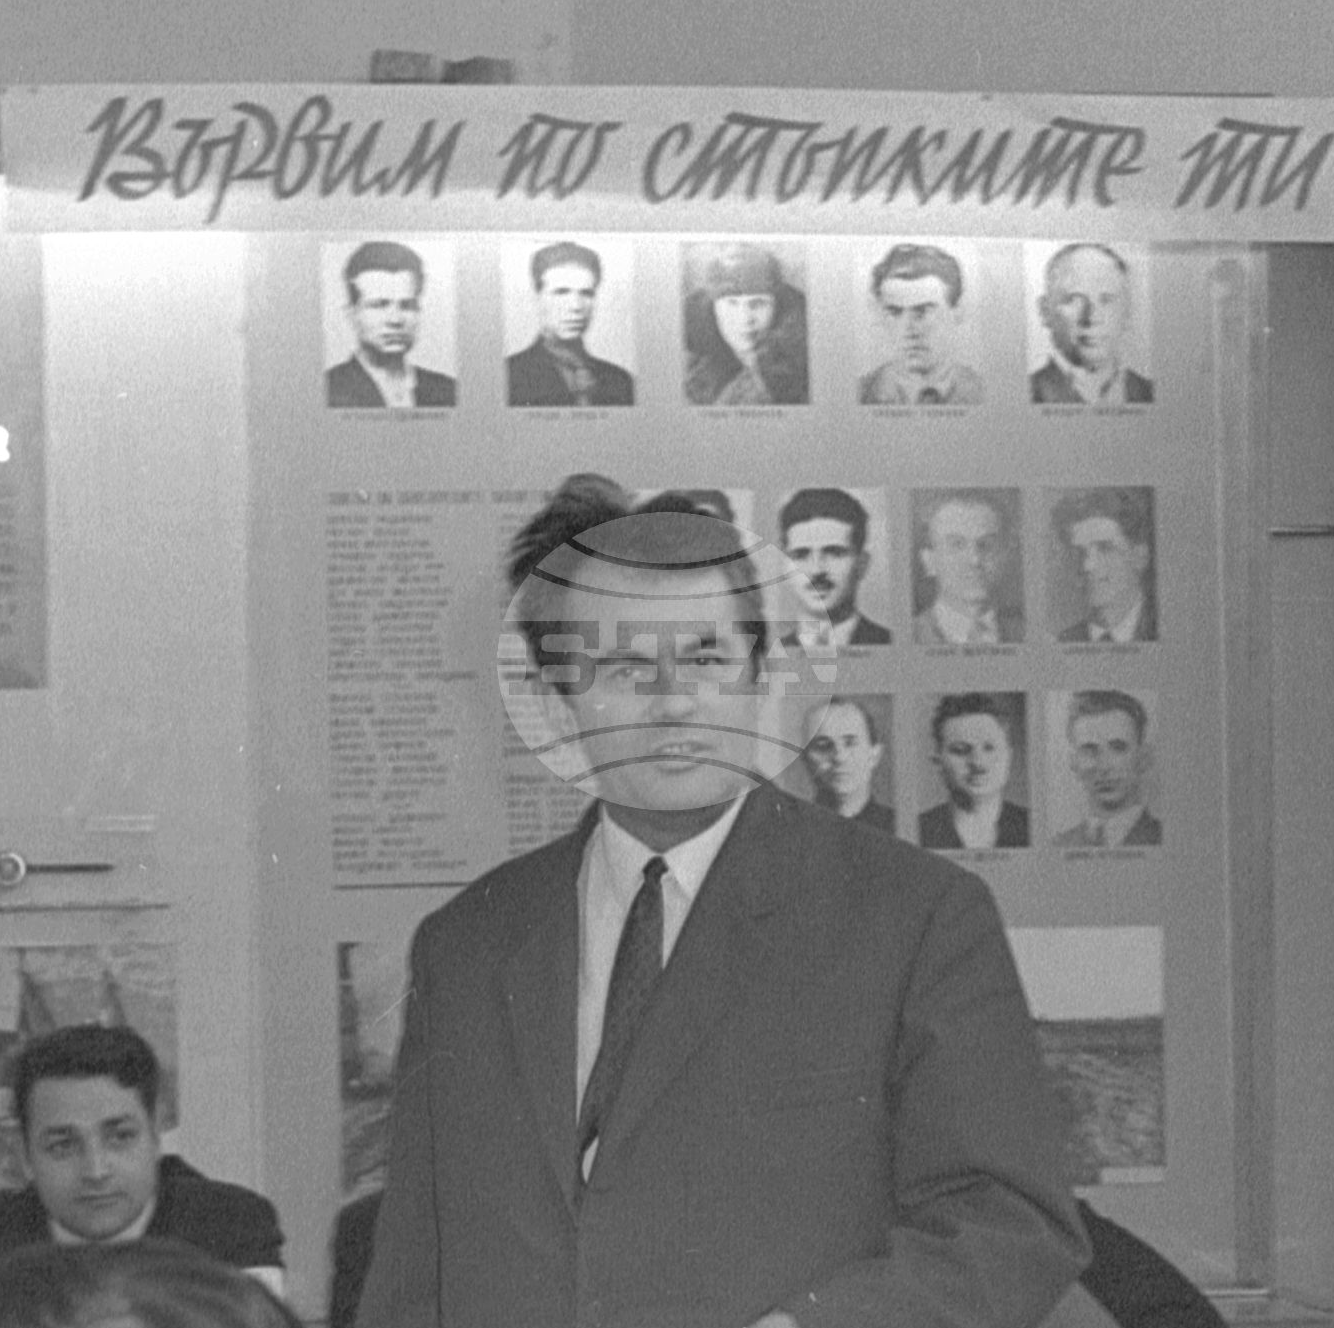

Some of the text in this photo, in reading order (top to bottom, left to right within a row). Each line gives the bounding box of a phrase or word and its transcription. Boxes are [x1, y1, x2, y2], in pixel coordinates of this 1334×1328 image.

[76, 94, 464, 224] Вървим
[497, 112, 623, 201] по
[640, 111, 1147, 209] стъпките
